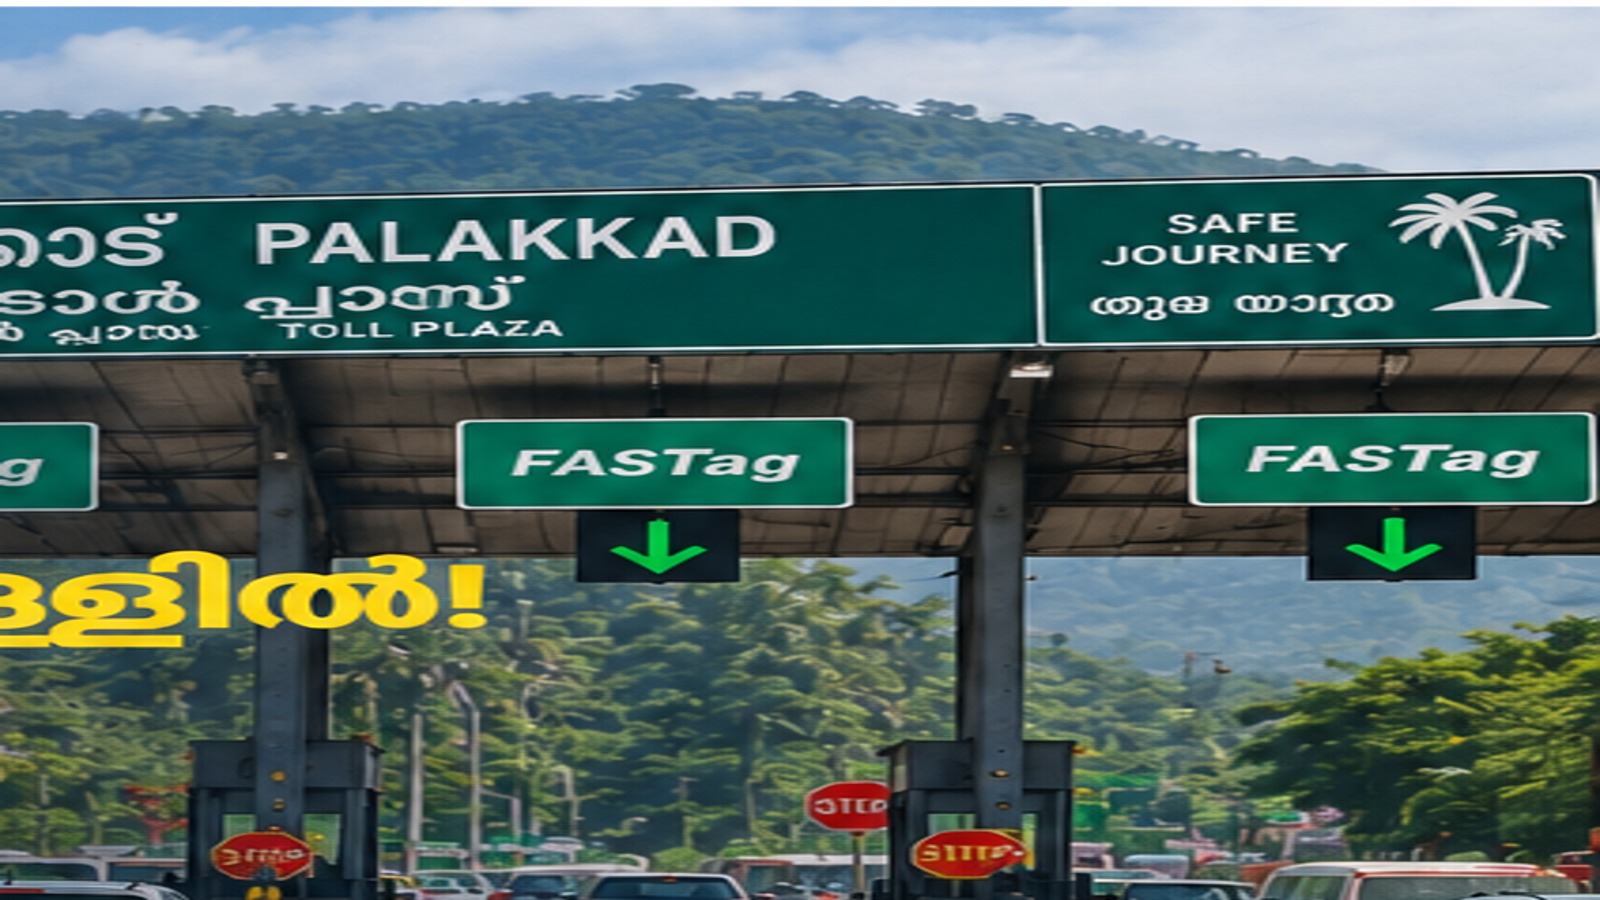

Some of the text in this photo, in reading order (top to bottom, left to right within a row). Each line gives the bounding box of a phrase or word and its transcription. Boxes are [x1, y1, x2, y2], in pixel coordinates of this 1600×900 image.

[1167, 212, 1299, 235] SAFE
[256, 215, 776, 265] PALAKKAD
[1101, 242, 1349, 266] JOURNEY
[279, 319, 564, 339] TOLL PLAZA
[511, 448, 801, 483] FASTag
[1246, 444, 1540, 479] FASTag
